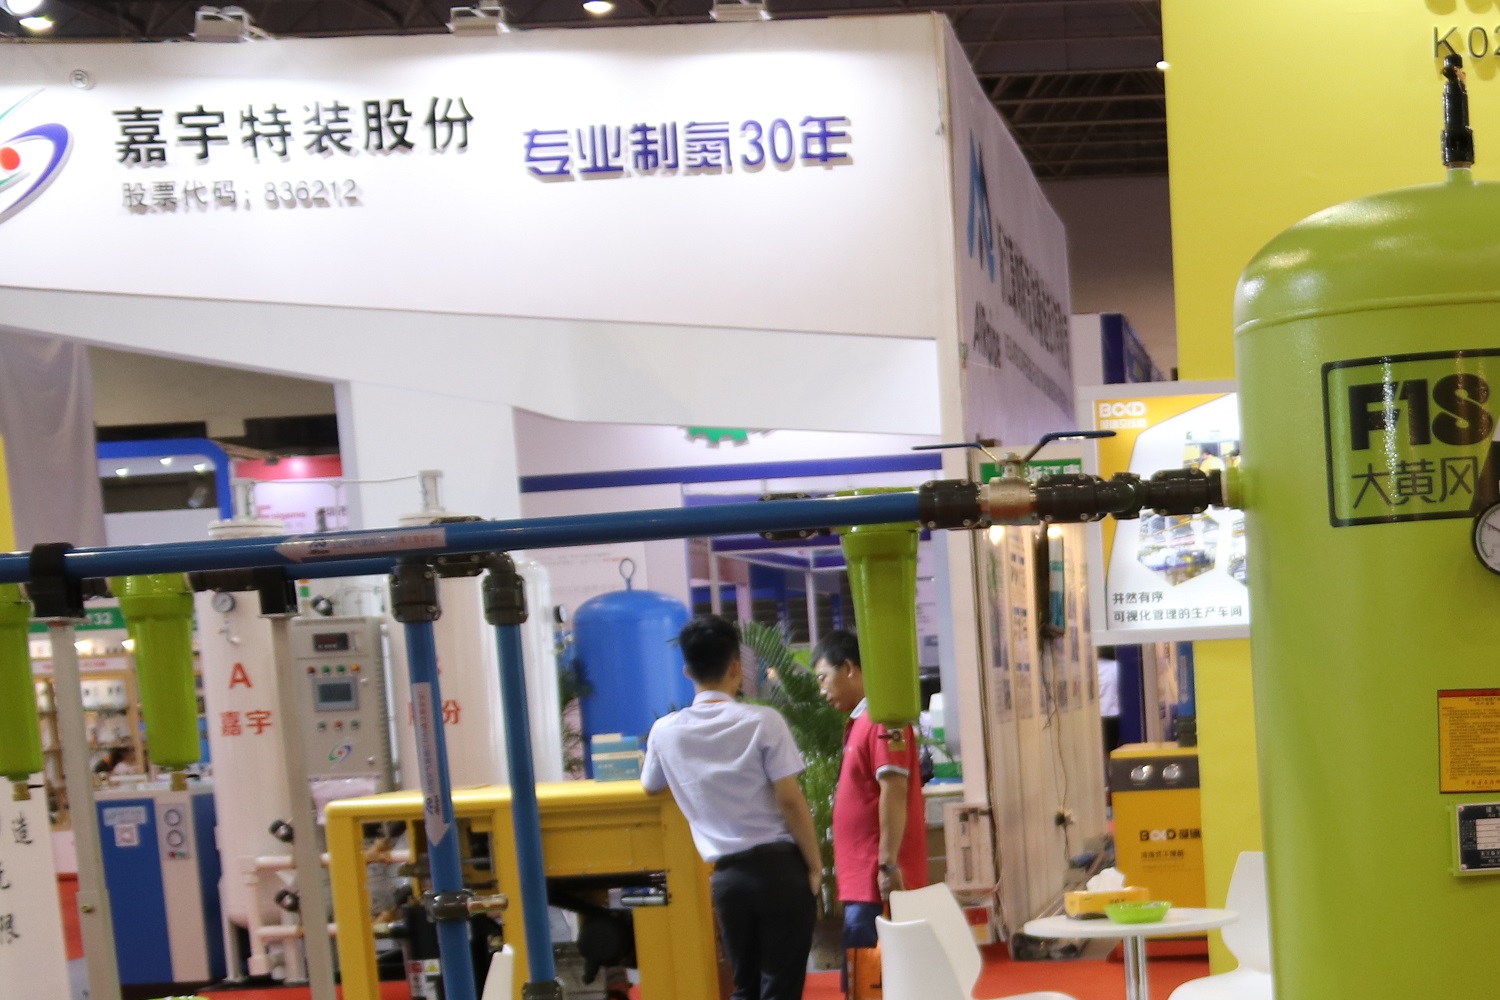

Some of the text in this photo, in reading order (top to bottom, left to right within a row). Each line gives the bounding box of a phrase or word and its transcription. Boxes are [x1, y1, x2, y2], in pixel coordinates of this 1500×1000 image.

[111, 96, 474, 165] 嘉宇特装股份
[1351, 456, 1480, 509] 大黄风
[1113, 591, 1163, 604] 井然有序
[229, 662, 252, 689] A
